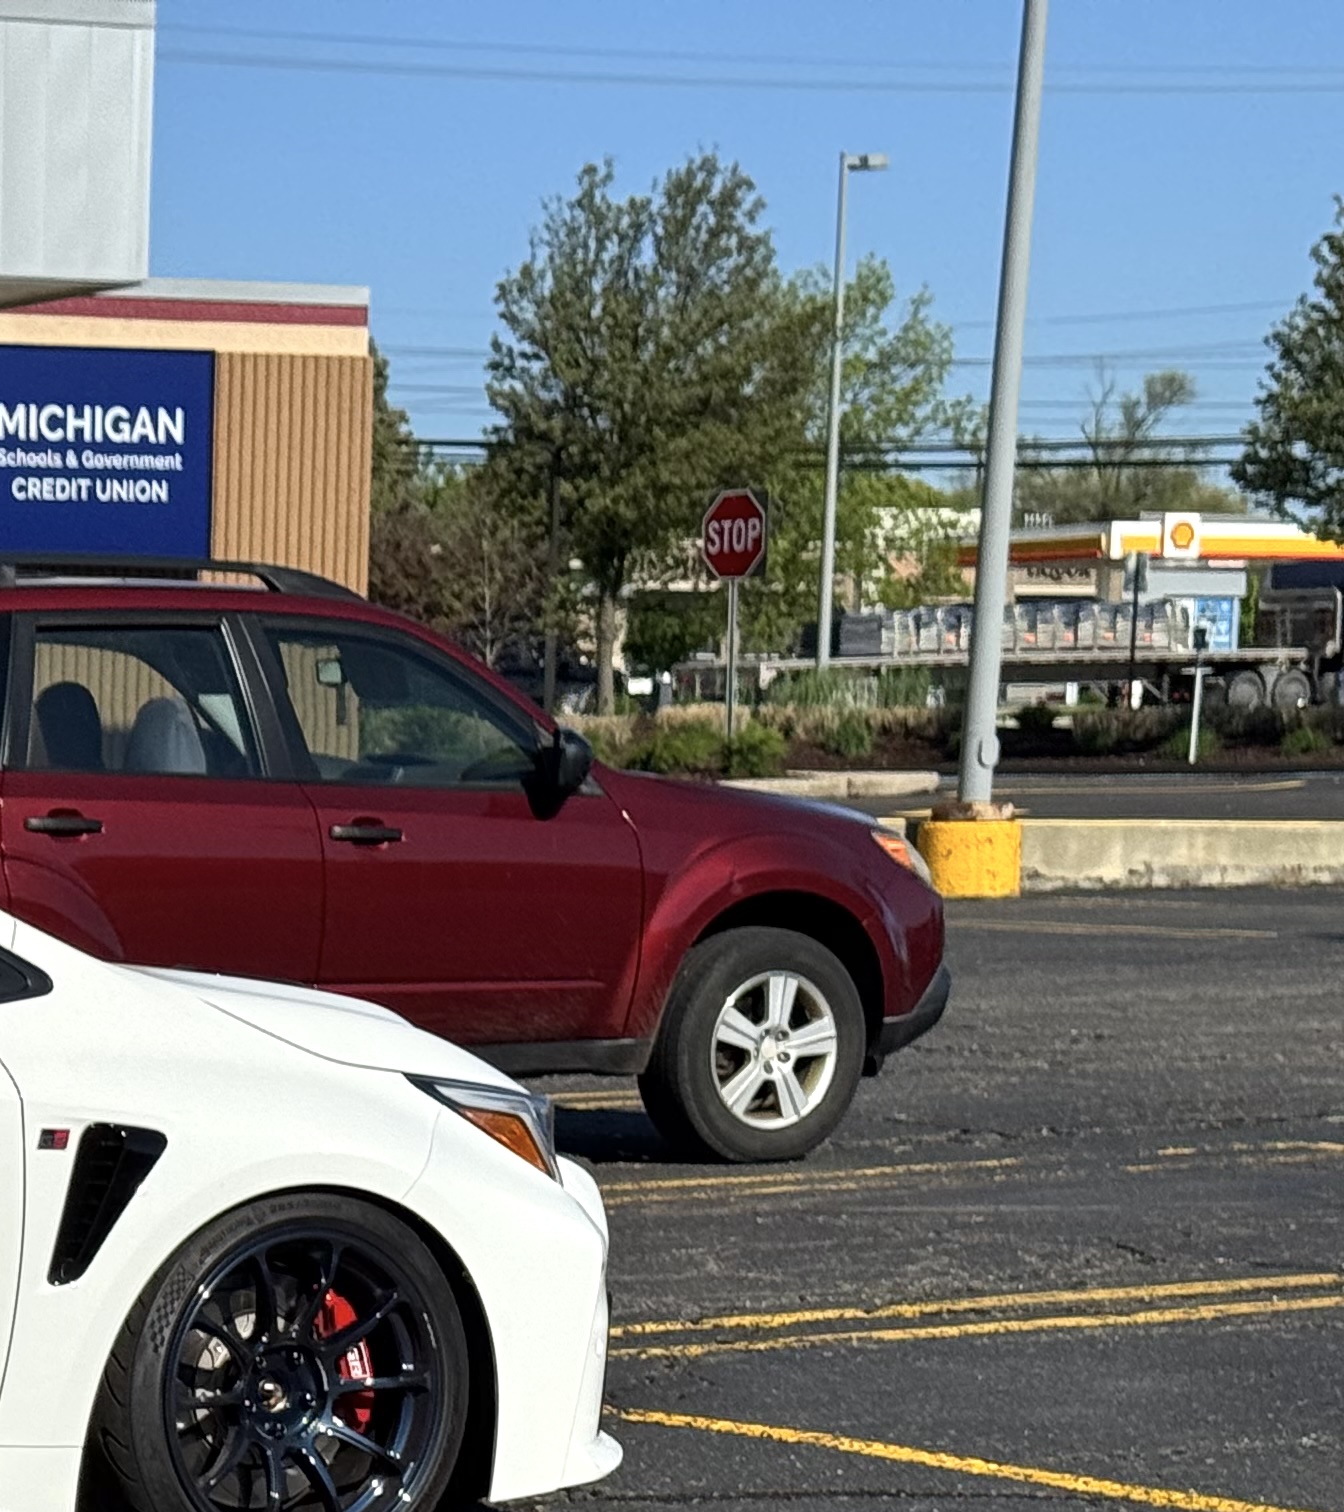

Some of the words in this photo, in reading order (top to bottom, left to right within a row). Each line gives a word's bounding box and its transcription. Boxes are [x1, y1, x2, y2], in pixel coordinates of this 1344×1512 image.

[65, 449, 79, 469] &
[81, 450, 183, 471] Government
[12, 476, 92, 501] CREDIT
[95, 478, 169, 504] UNION
[707, 517, 760, 556] STOP
